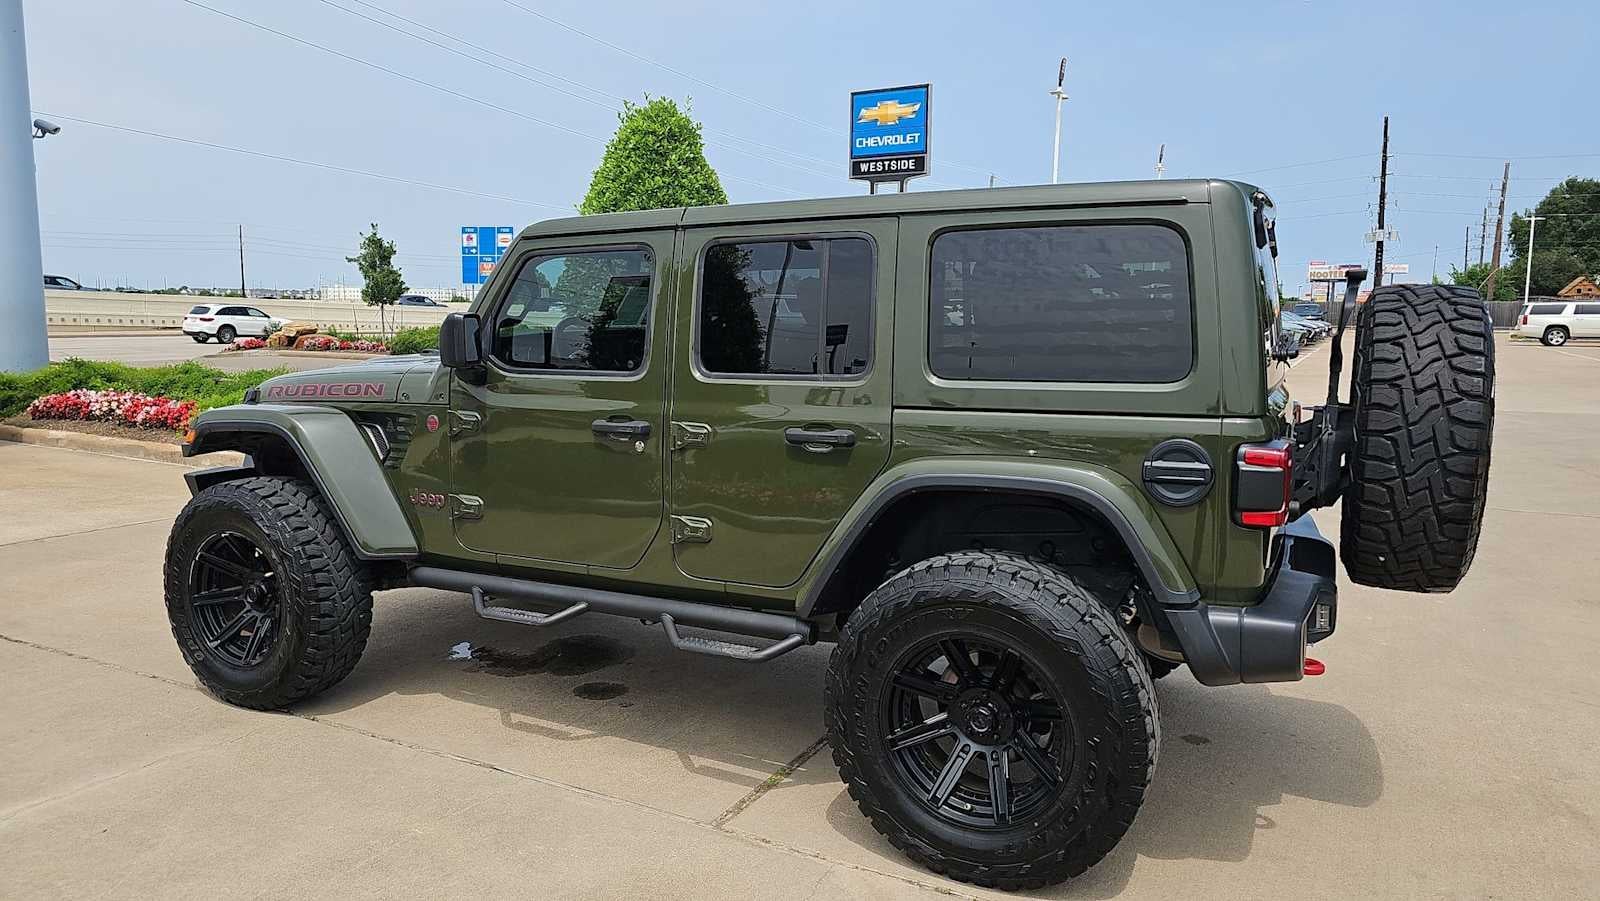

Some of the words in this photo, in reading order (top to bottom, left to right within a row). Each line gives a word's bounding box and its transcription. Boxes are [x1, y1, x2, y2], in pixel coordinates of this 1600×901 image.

[856, 133, 920, 148] CHEVROLET
[860, 160, 916, 172] WESTSIDE
[1309, 270, 1345, 279] HOOTER
[267, 383, 385, 398] RUBICON
[409, 487, 445, 509] Jeep
